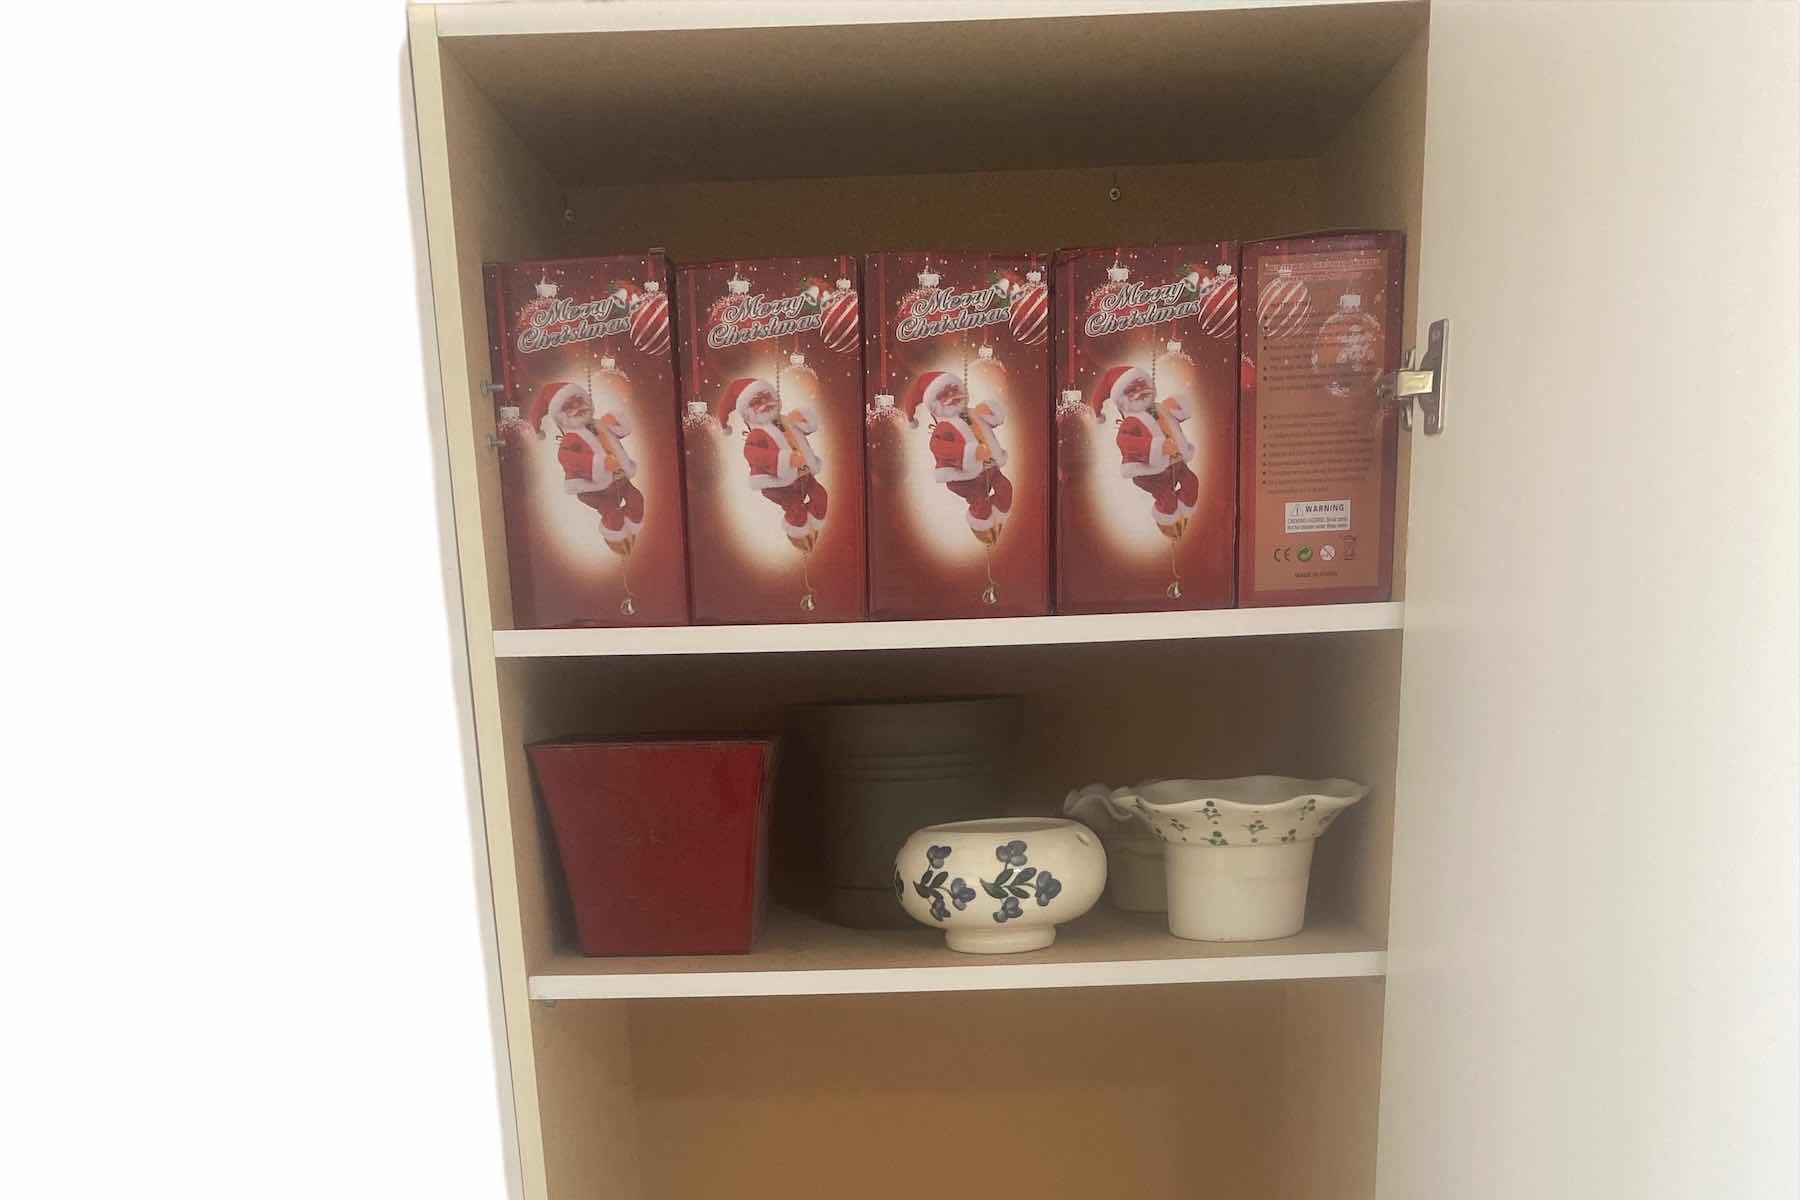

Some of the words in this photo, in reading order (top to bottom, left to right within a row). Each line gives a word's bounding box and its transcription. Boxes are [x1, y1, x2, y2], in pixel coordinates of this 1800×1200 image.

[534, 296, 614, 326] Merry
[722, 293, 806, 322] Merry
[912, 286, 996, 318] Merry
[1101, 281, 1185, 311] Merry
[518, 316, 631, 352] Christmas
[708, 312, 822, 348] Christmas
[897, 307, 1010, 342] Christmas
[1086, 301, 1200, 338] Christmas
[1305, 503, 1344, 512] WARNING
